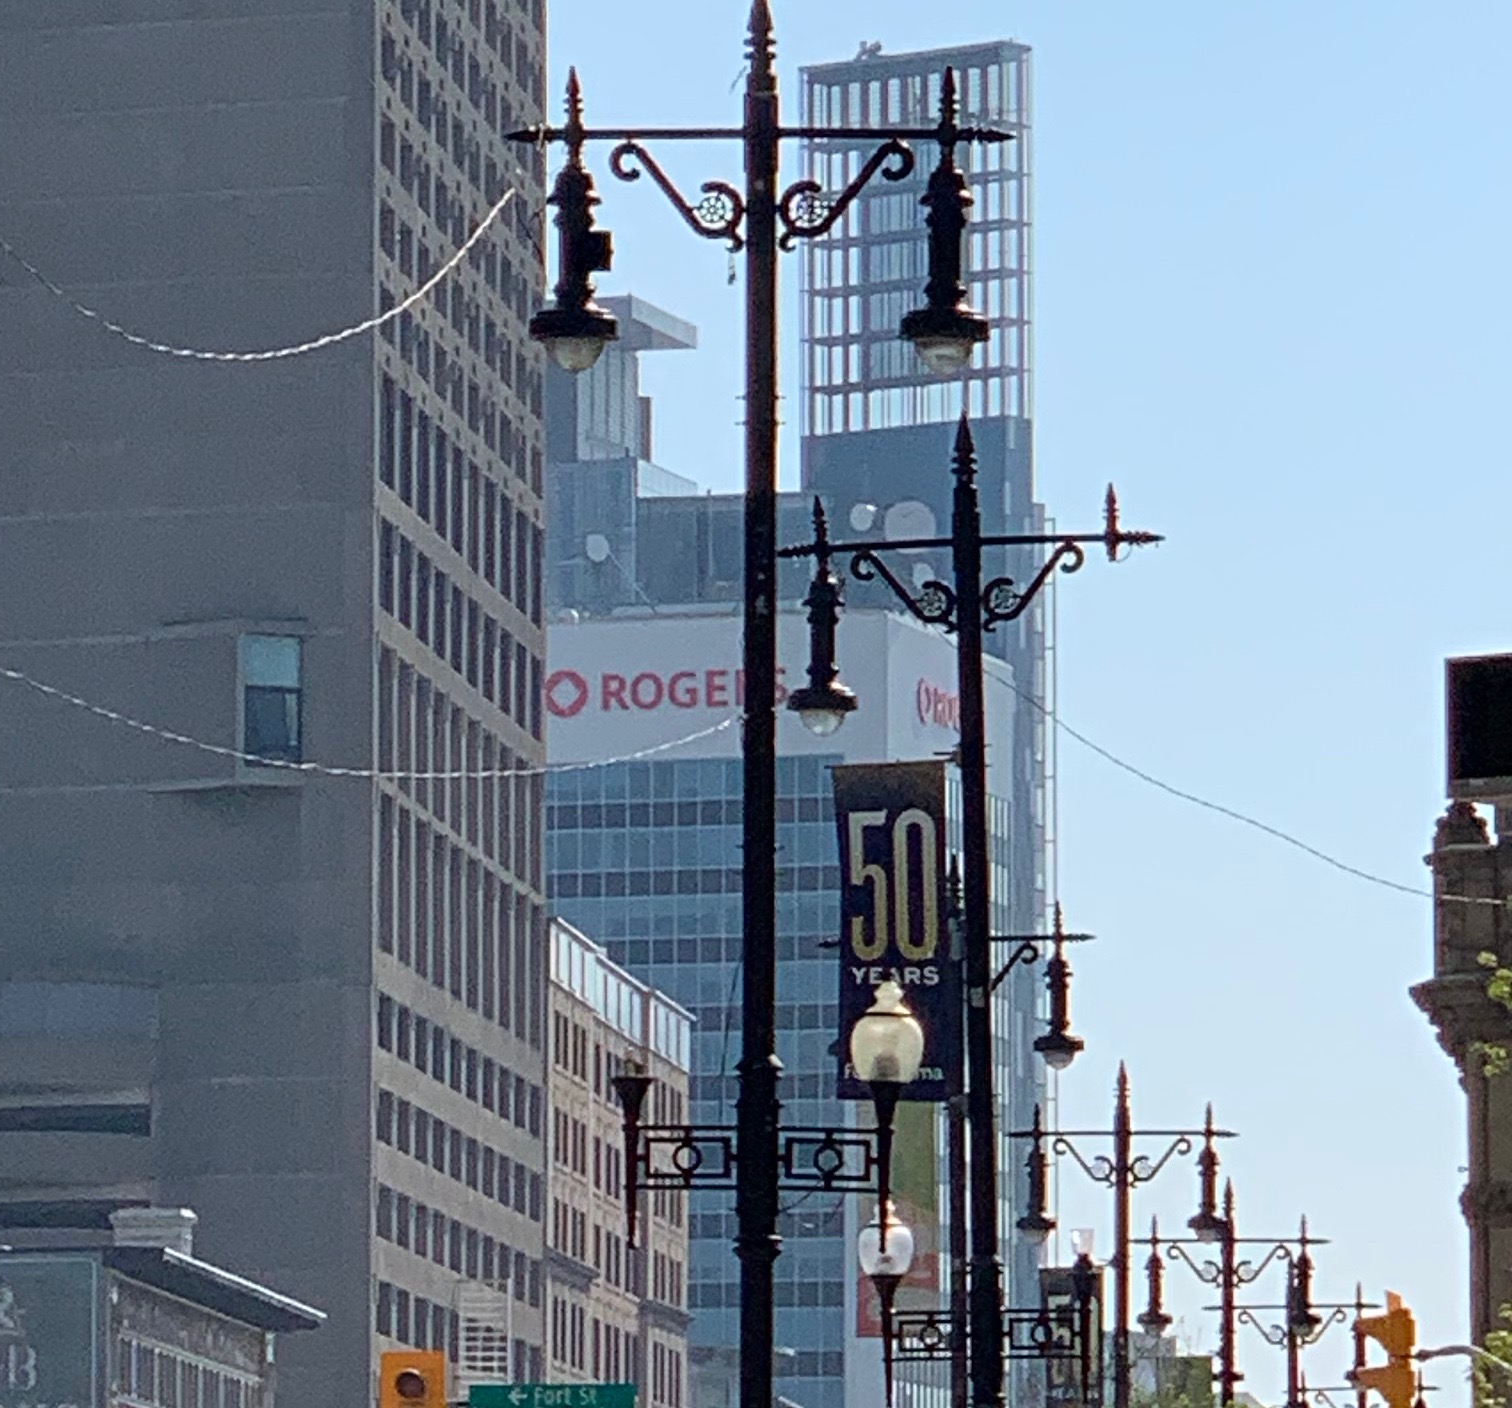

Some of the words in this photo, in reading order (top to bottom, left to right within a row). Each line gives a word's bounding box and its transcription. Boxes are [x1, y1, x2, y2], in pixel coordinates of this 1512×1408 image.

[601, 667, 788, 712] ROGES
[848, 807, 939, 961] 50
[533, 1386, 572, 1406] Fort
[579, 1386, 597, 1405] St
